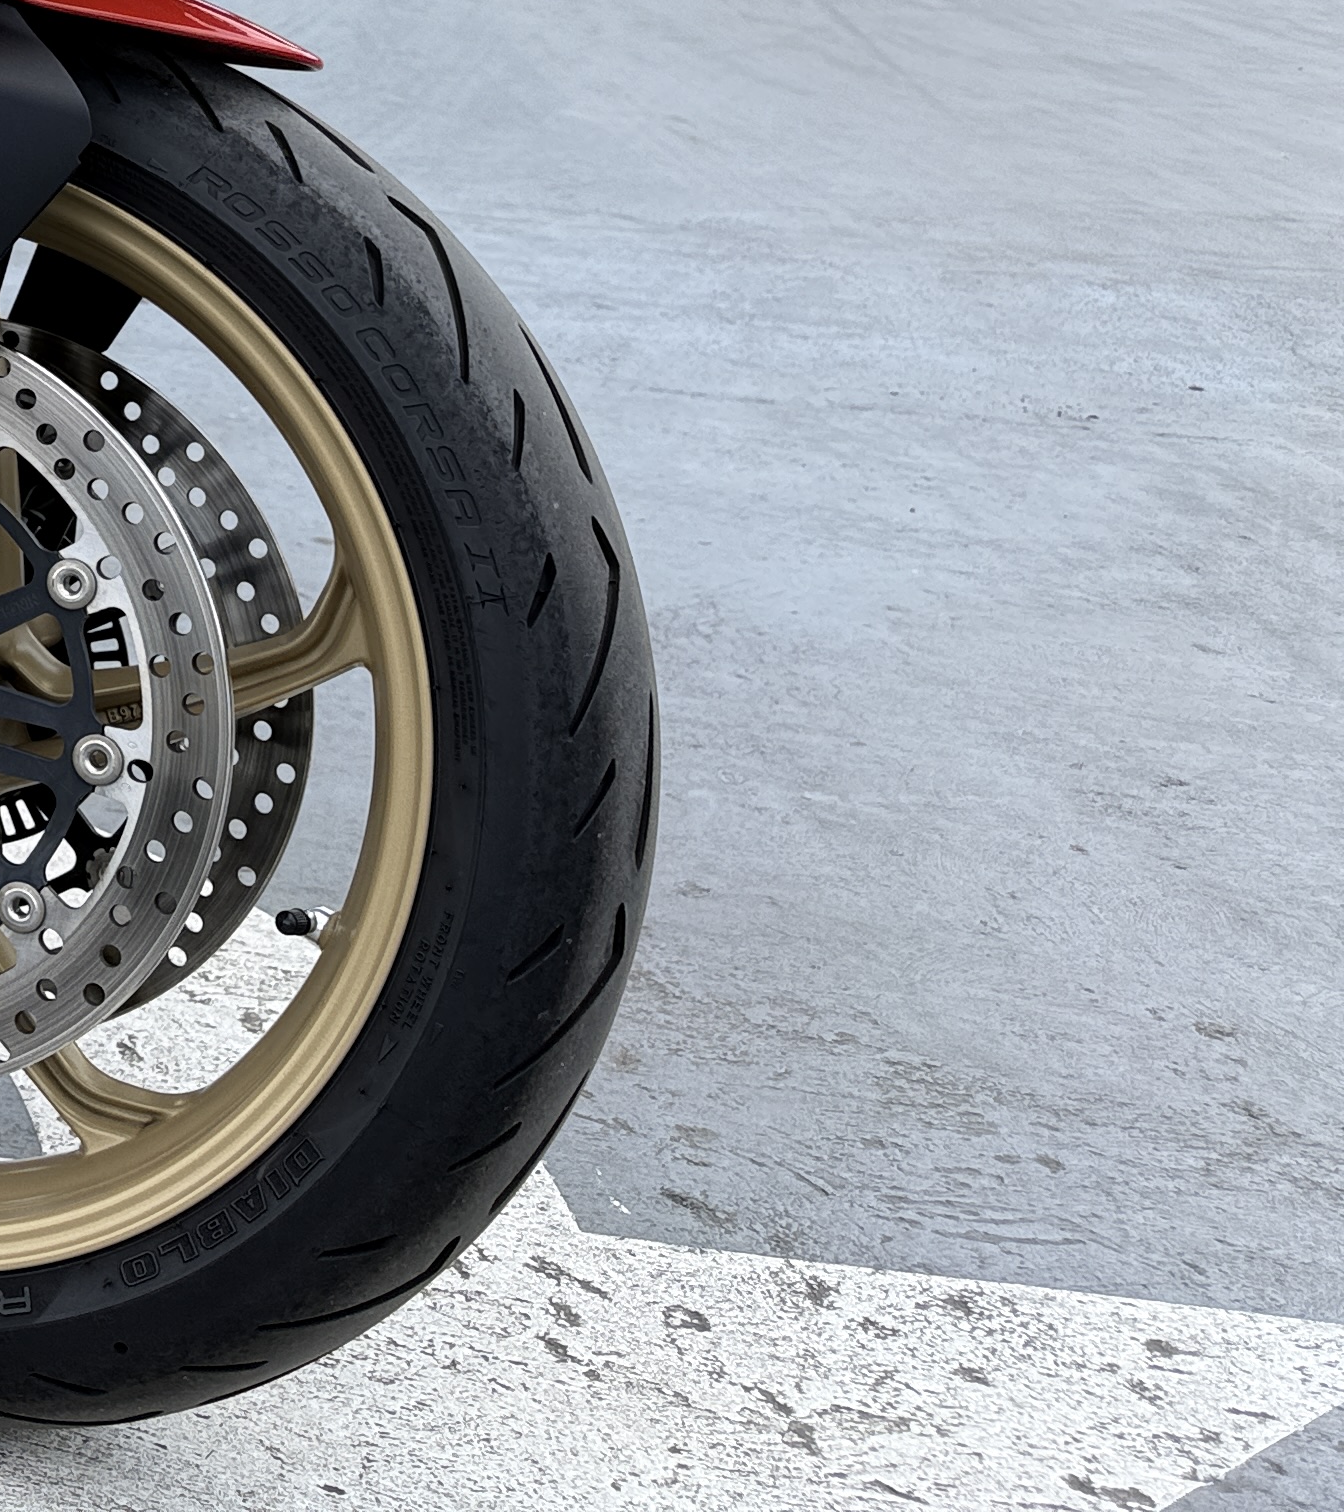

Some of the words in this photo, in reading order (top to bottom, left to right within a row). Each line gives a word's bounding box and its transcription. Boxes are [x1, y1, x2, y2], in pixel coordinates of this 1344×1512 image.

[187, 166, 364, 317] ROSSO
[356, 326, 483, 528] CORSA
[389, 936, 431, 1026] ROTATION
[428, 910, 454, 970] FRONT
[401, 975, 434, 1030] WHEEL
[118, 1135, 327, 1289] DIABLO
